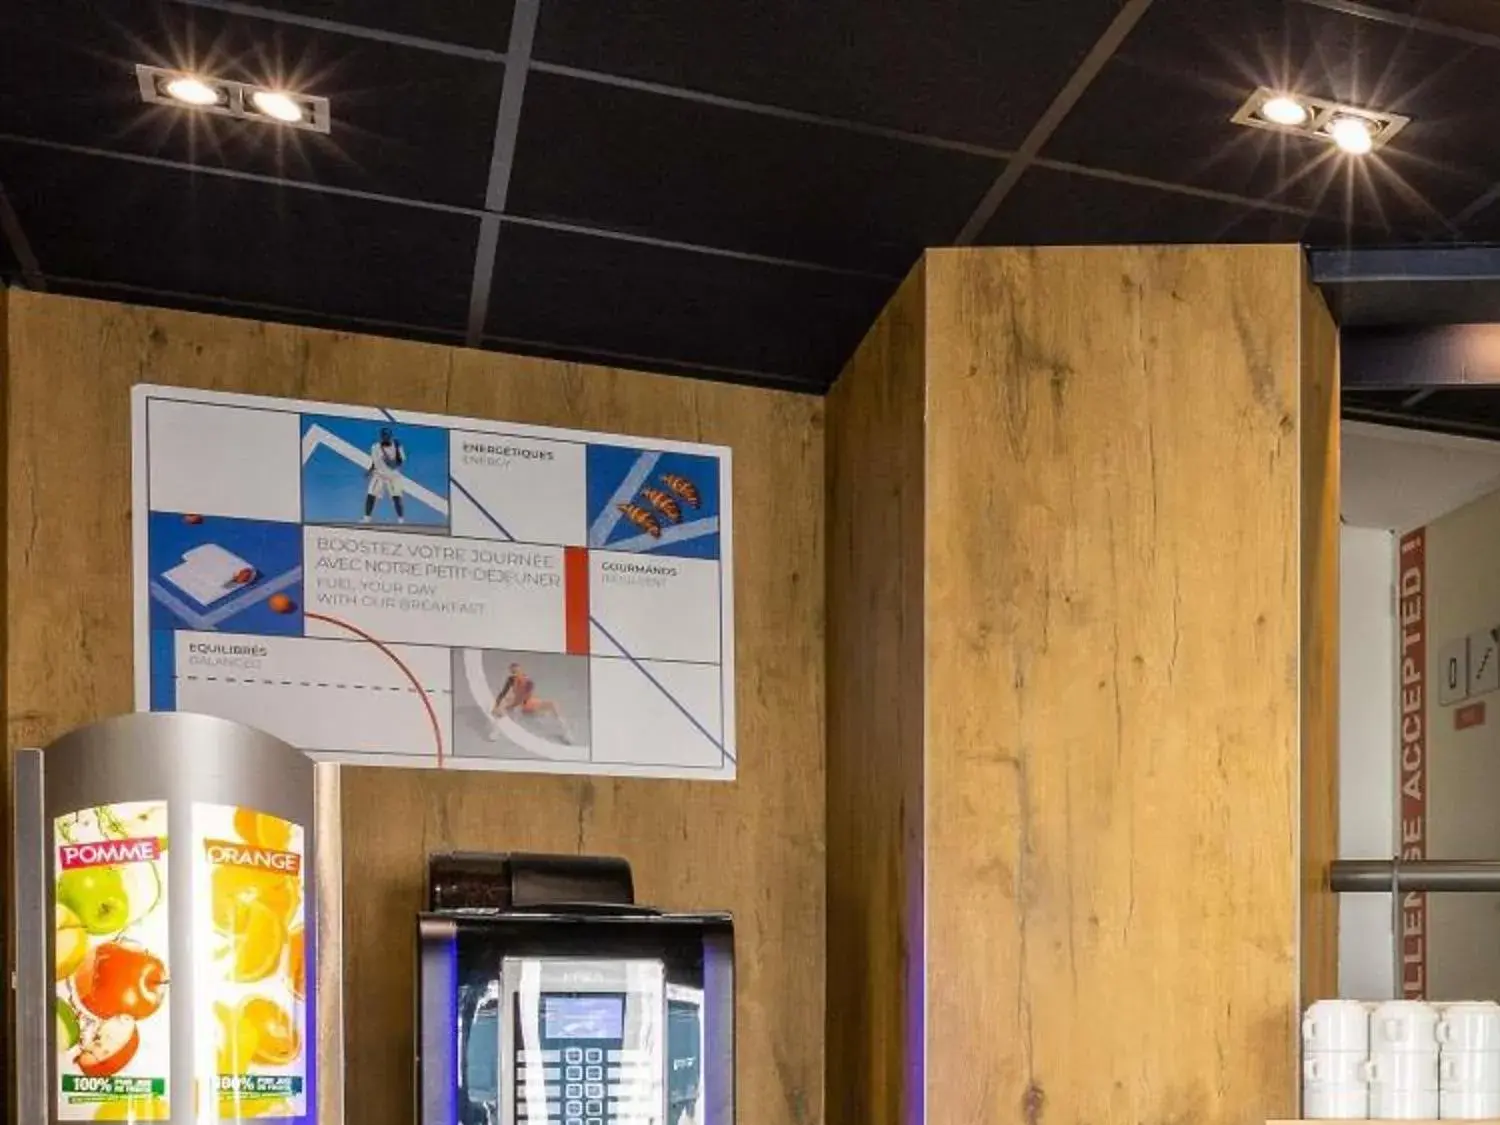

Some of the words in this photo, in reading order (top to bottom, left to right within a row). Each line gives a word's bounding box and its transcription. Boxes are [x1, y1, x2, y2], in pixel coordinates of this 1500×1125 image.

[317, 537, 402, 557] BOOSTEZ
[407, 544, 467, 561] VOTRE
[317, 556, 361, 571] AVEC
[366, 559, 423, 575] NOTRE
[602, 562, 677, 577] GOURMANDS
[317, 577, 351, 590] FUEL
[361, 580, 403, 593] YOUR
[408, 583, 437, 595] DAY
[317, 593, 357, 607] WITH
[362, 596, 395, 609] OUR
[399, 597, 486, 615] BREAKFAST
[1402, 567, 1422, 799] ACCEPTED
[64, 841, 154, 864] POMME
[207, 844, 300, 871] ORANGE
[73, 1077, 113, 1093] 100%
